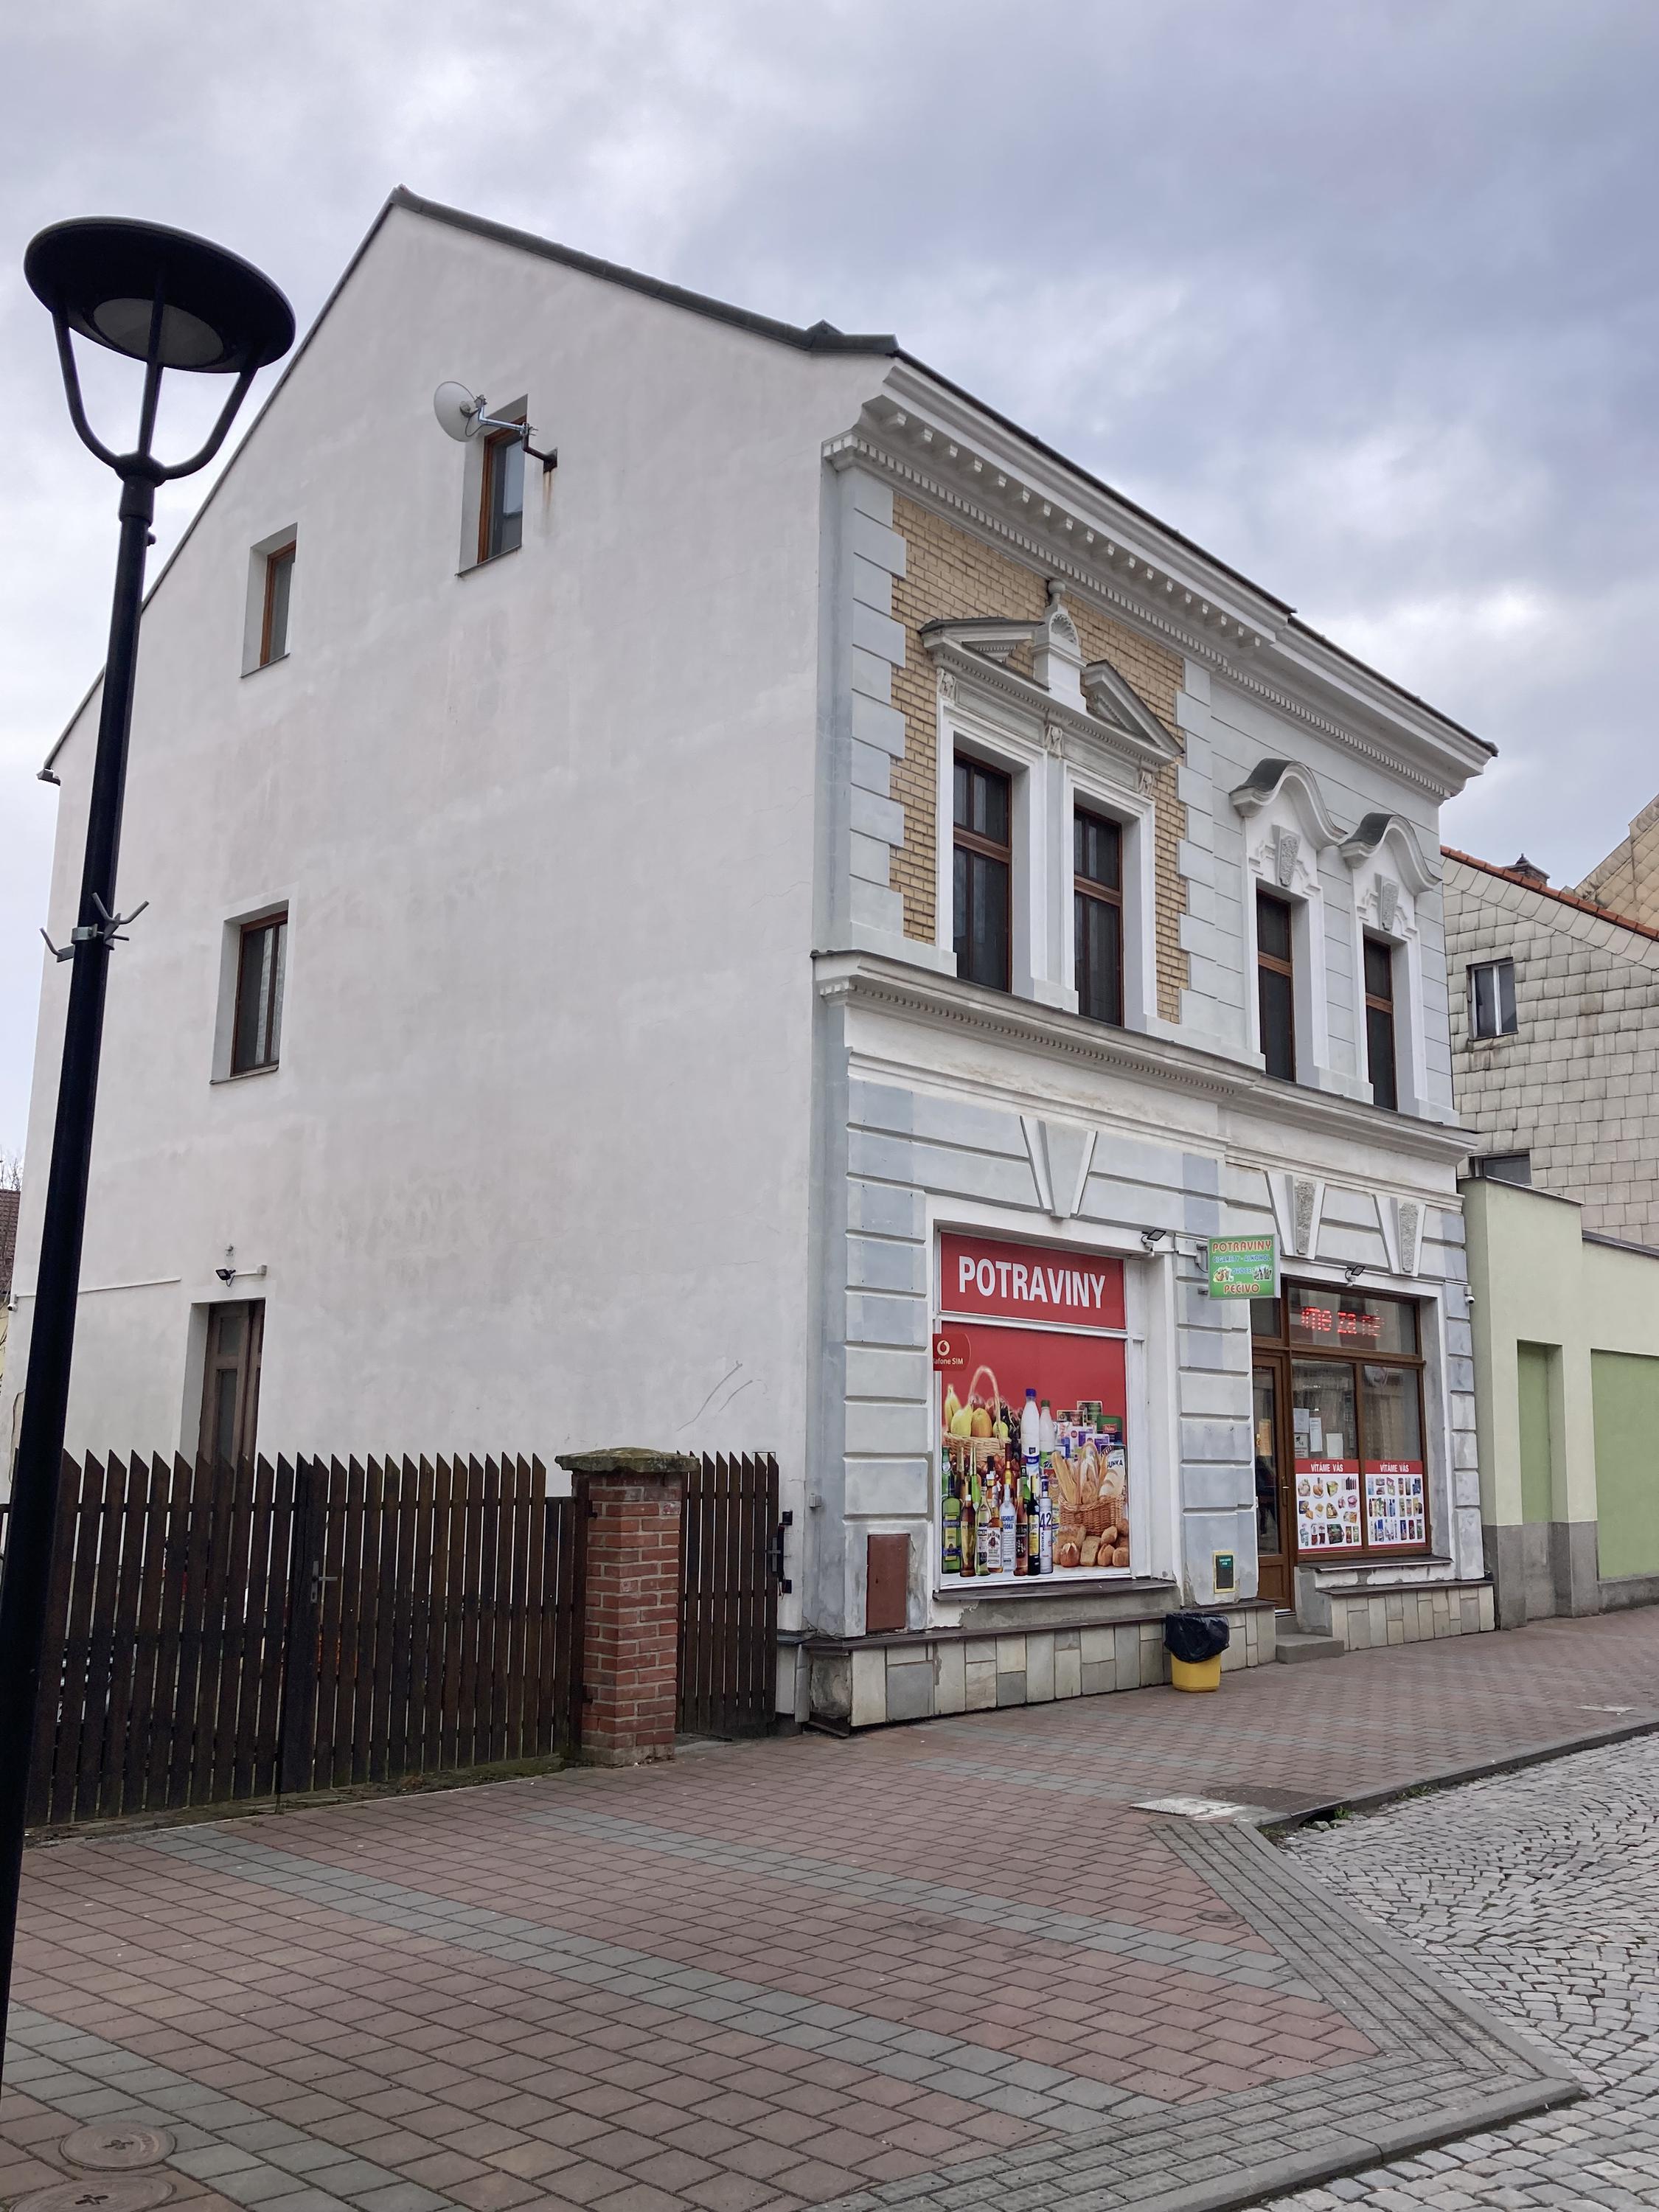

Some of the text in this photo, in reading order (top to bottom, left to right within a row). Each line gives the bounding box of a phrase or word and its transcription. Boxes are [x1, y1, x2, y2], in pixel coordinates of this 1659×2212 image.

[1213, 1240, 1271, 1253] POTRAVINY
[959, 1255, 1106, 1309] POTRAVINY
[1224, 1281, 1259, 1294] PEČIVO
[1310, 1461, 1343, 1472] VÍTÁME VÁS
[1380, 1462, 1409, 1472] VÍTÁME VÁS
